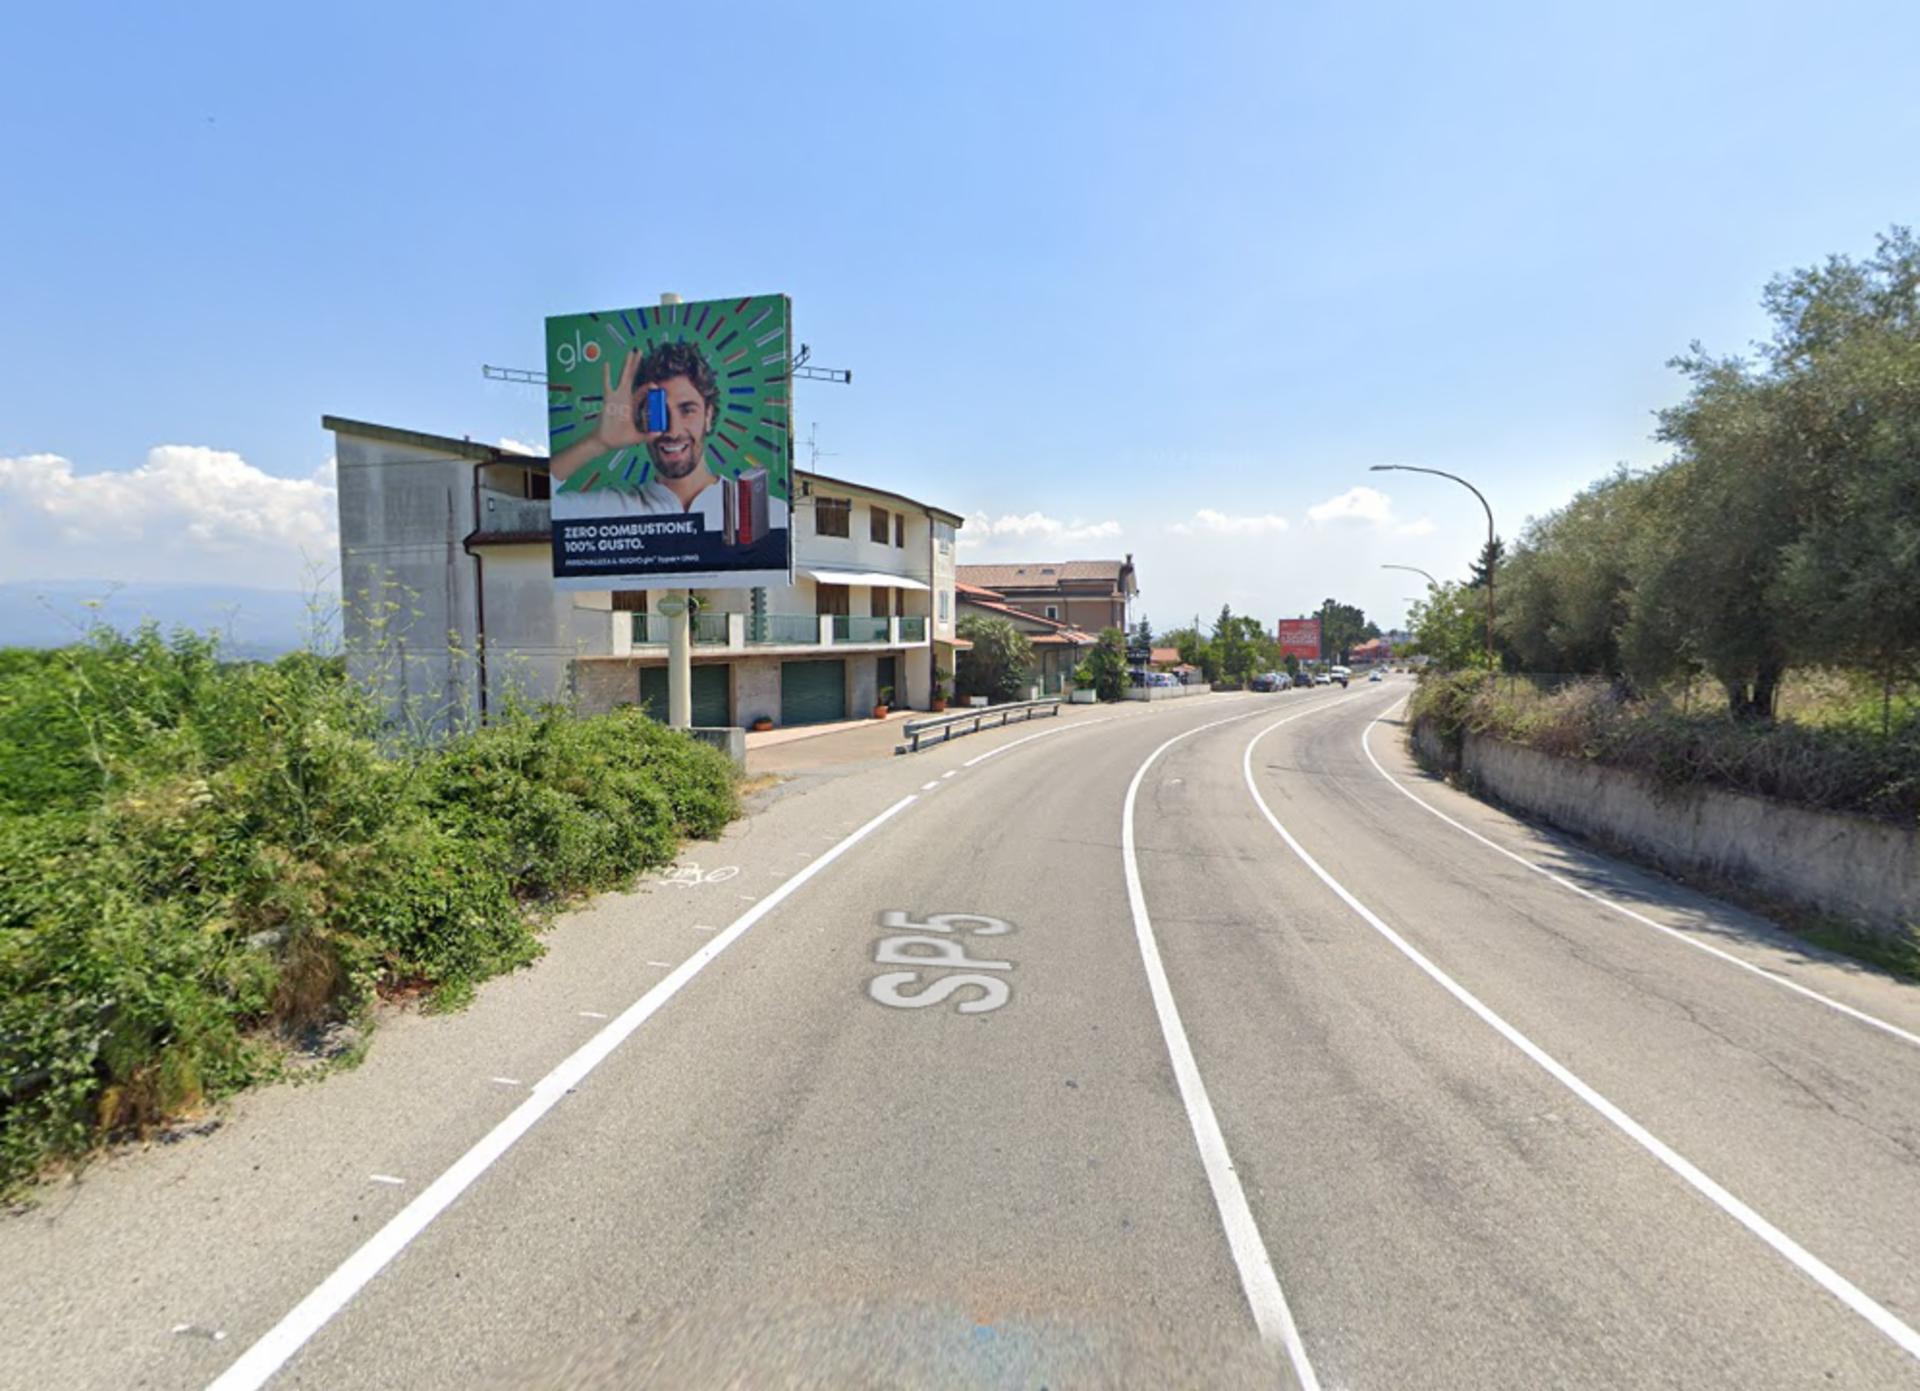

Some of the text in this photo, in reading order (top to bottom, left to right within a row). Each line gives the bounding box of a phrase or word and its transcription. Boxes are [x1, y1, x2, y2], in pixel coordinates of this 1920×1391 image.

[557, 329, 600, 373] glo
[564, 521, 698, 539] ZERO COMBUSTIONE,
[564, 538, 645, 552] 100% GUSTO.
